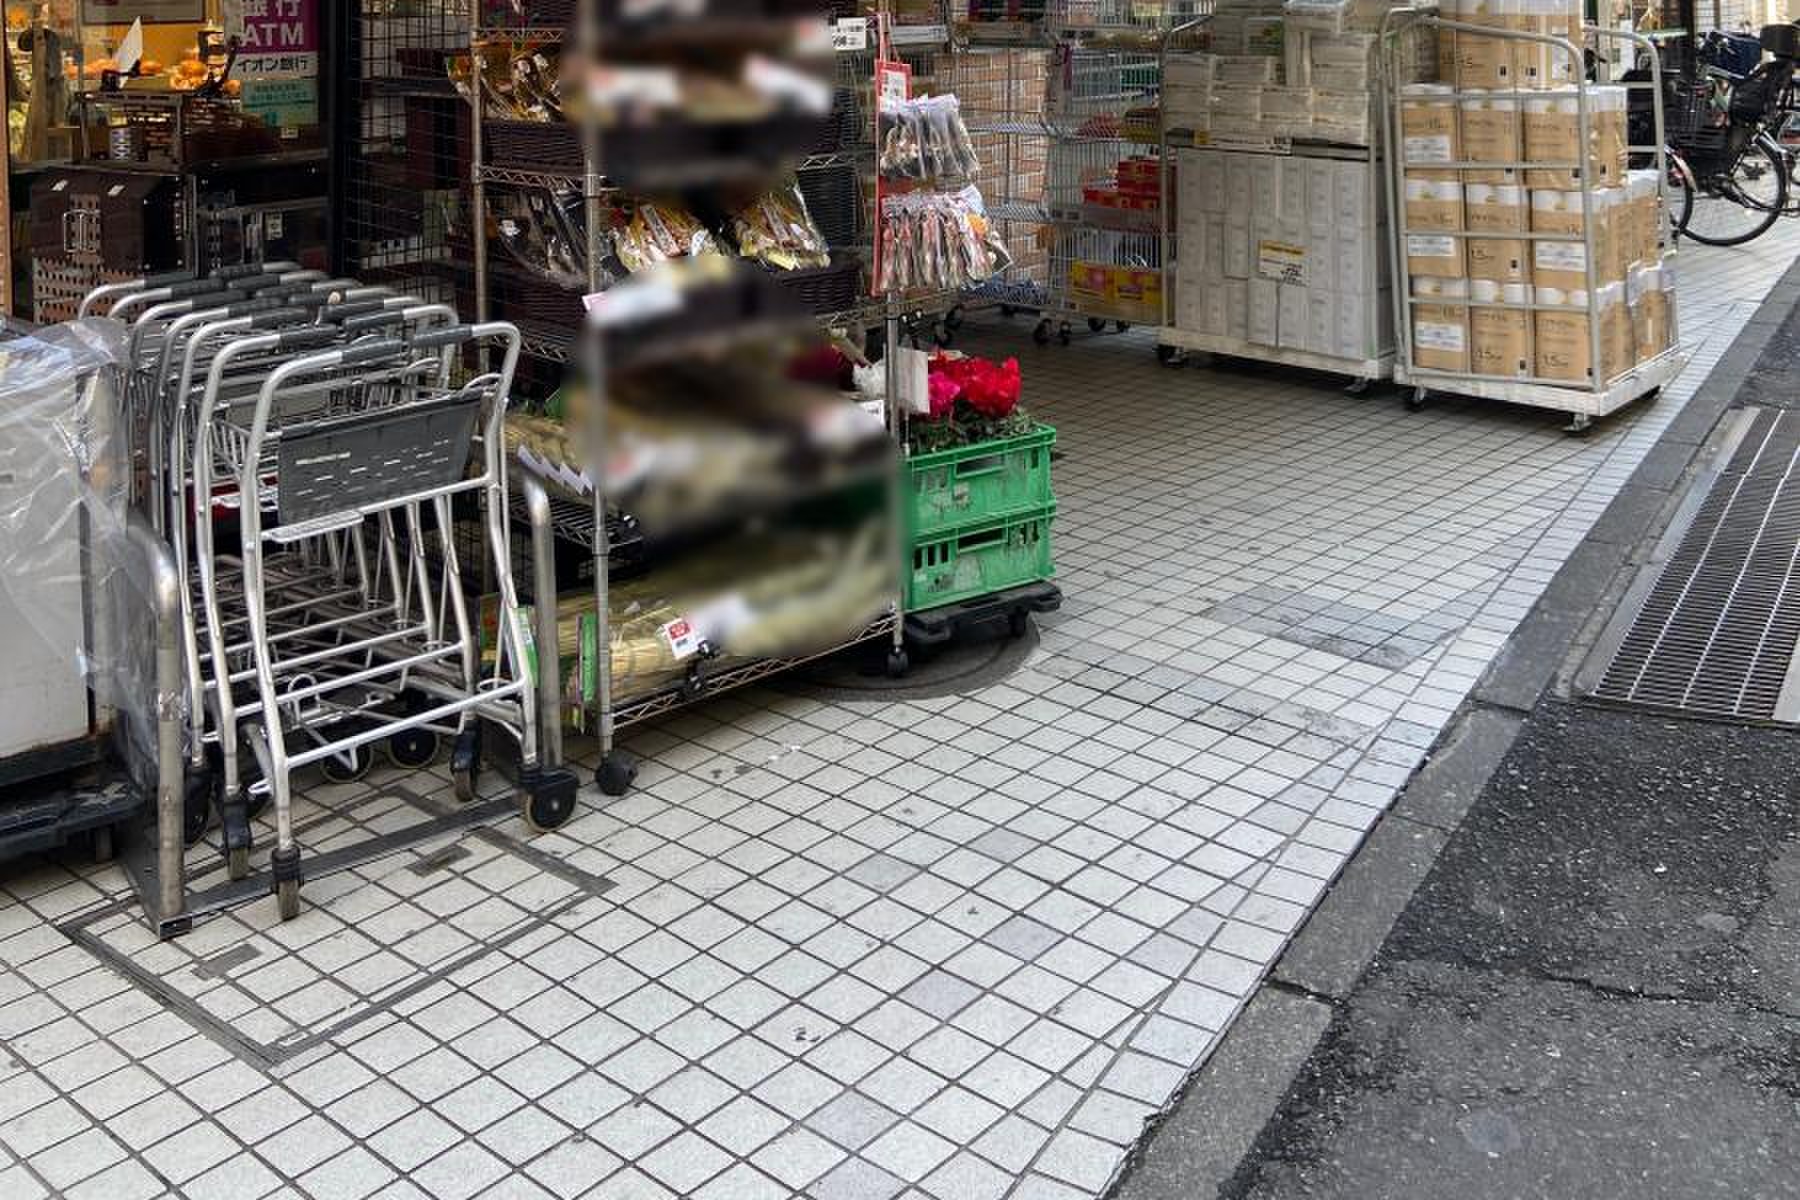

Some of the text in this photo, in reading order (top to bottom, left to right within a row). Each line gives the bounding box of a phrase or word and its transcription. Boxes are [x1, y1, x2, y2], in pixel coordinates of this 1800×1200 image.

[240, 22, 305, 47] ATM
[237, 56, 310, 74] イオン銀行
